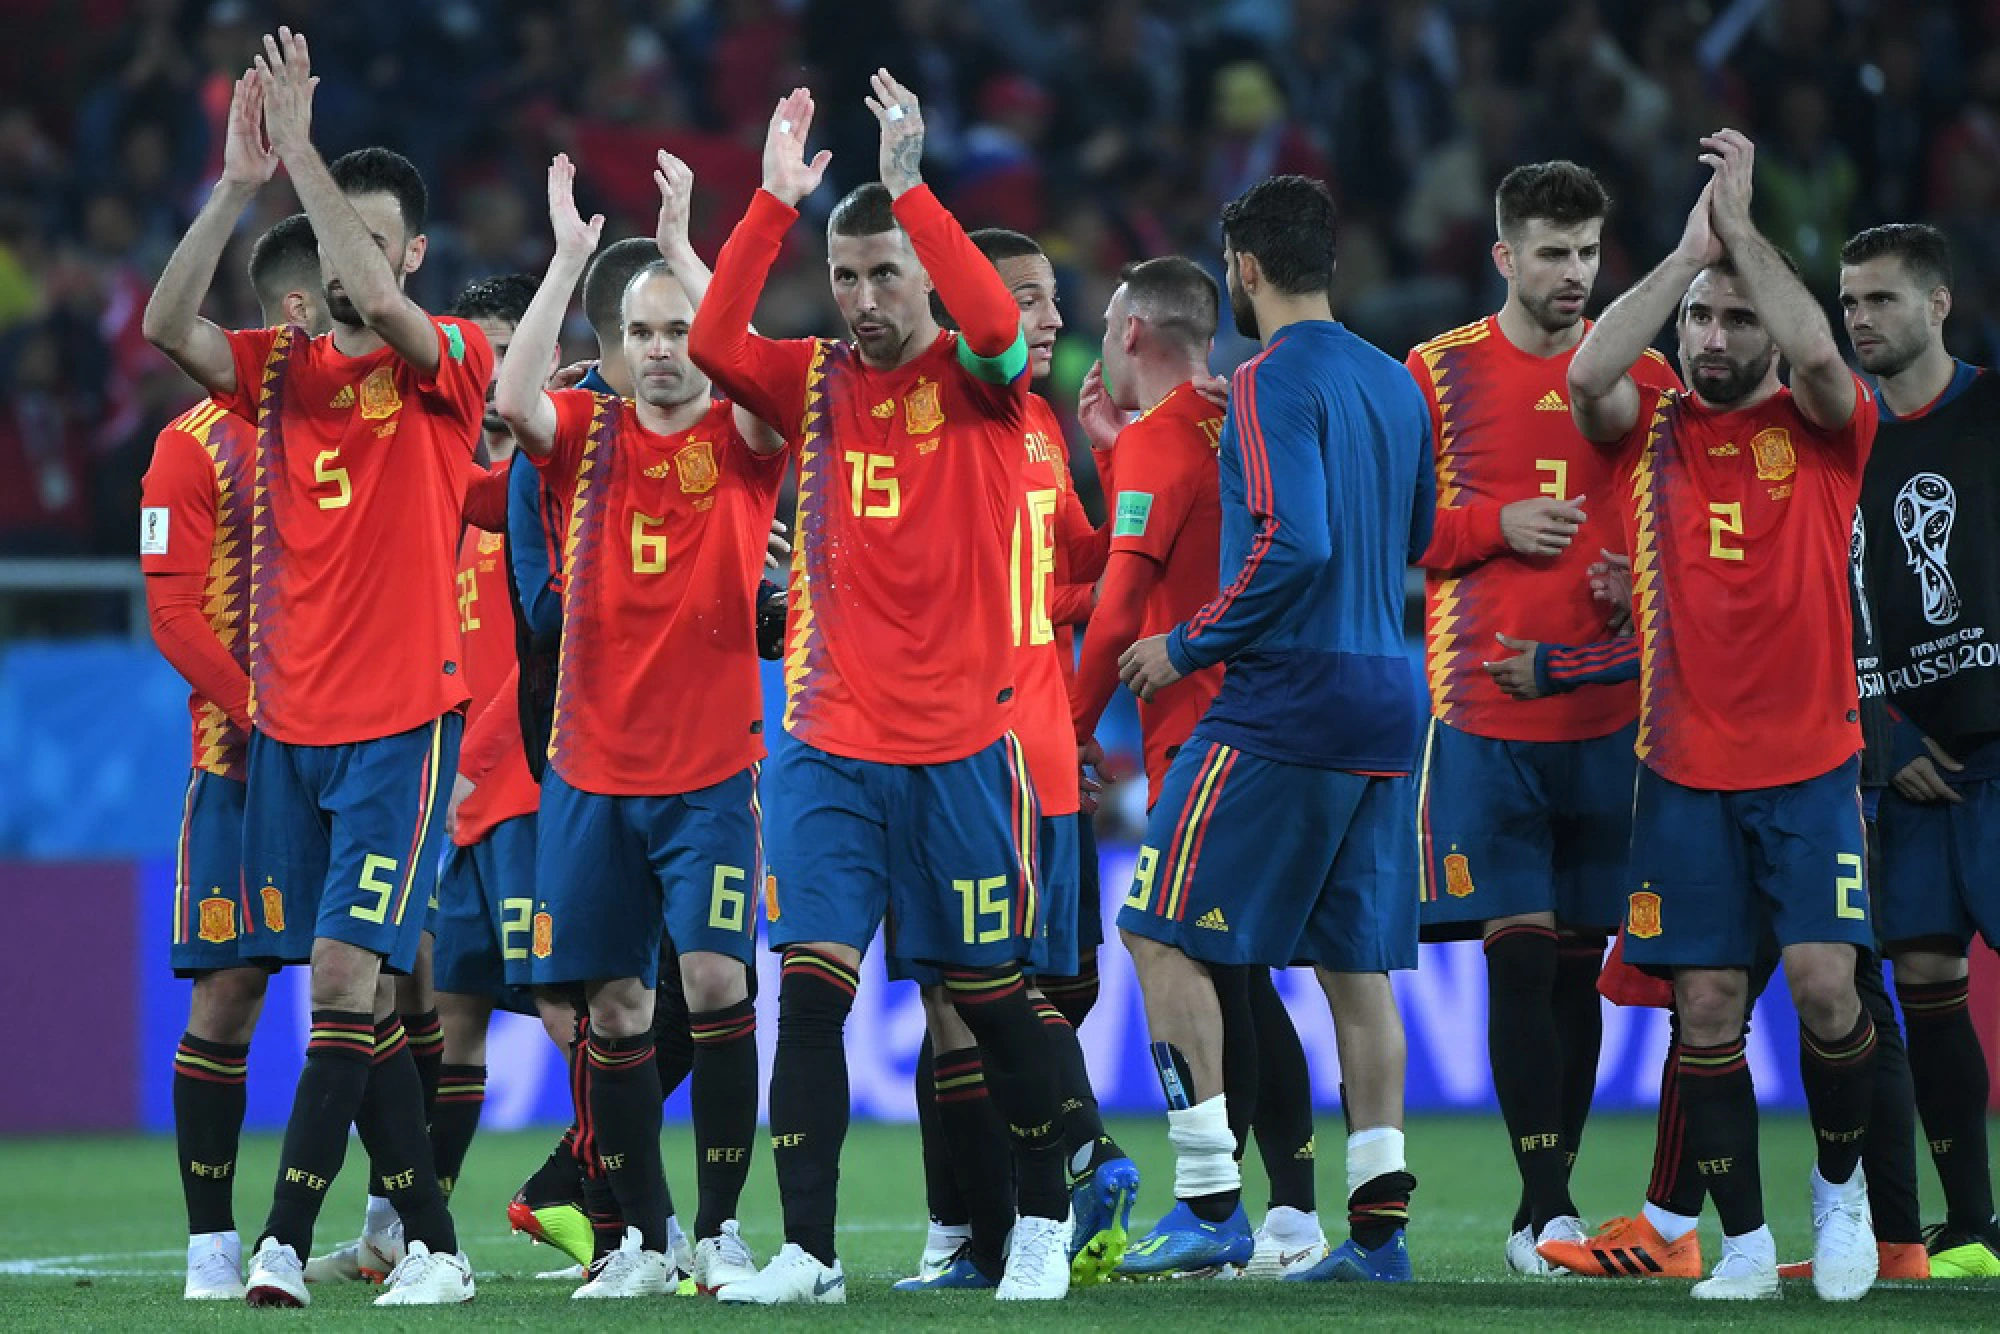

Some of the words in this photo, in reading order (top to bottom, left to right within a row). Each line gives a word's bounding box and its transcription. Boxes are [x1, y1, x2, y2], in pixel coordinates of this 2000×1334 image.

[315, 448, 352, 510] 5
[844, 450, 901, 518] 15
[1535, 459, 1567, 502] 3
[631, 511, 667, 575] 6
[1708, 501, 1746, 561] 2
[350, 853, 399, 925] 5
[708, 864, 747, 932] 6
[952, 875, 1010, 945] 15
[1123, 845, 1160, 913] 9
[1836, 852, 1865, 920] 2
